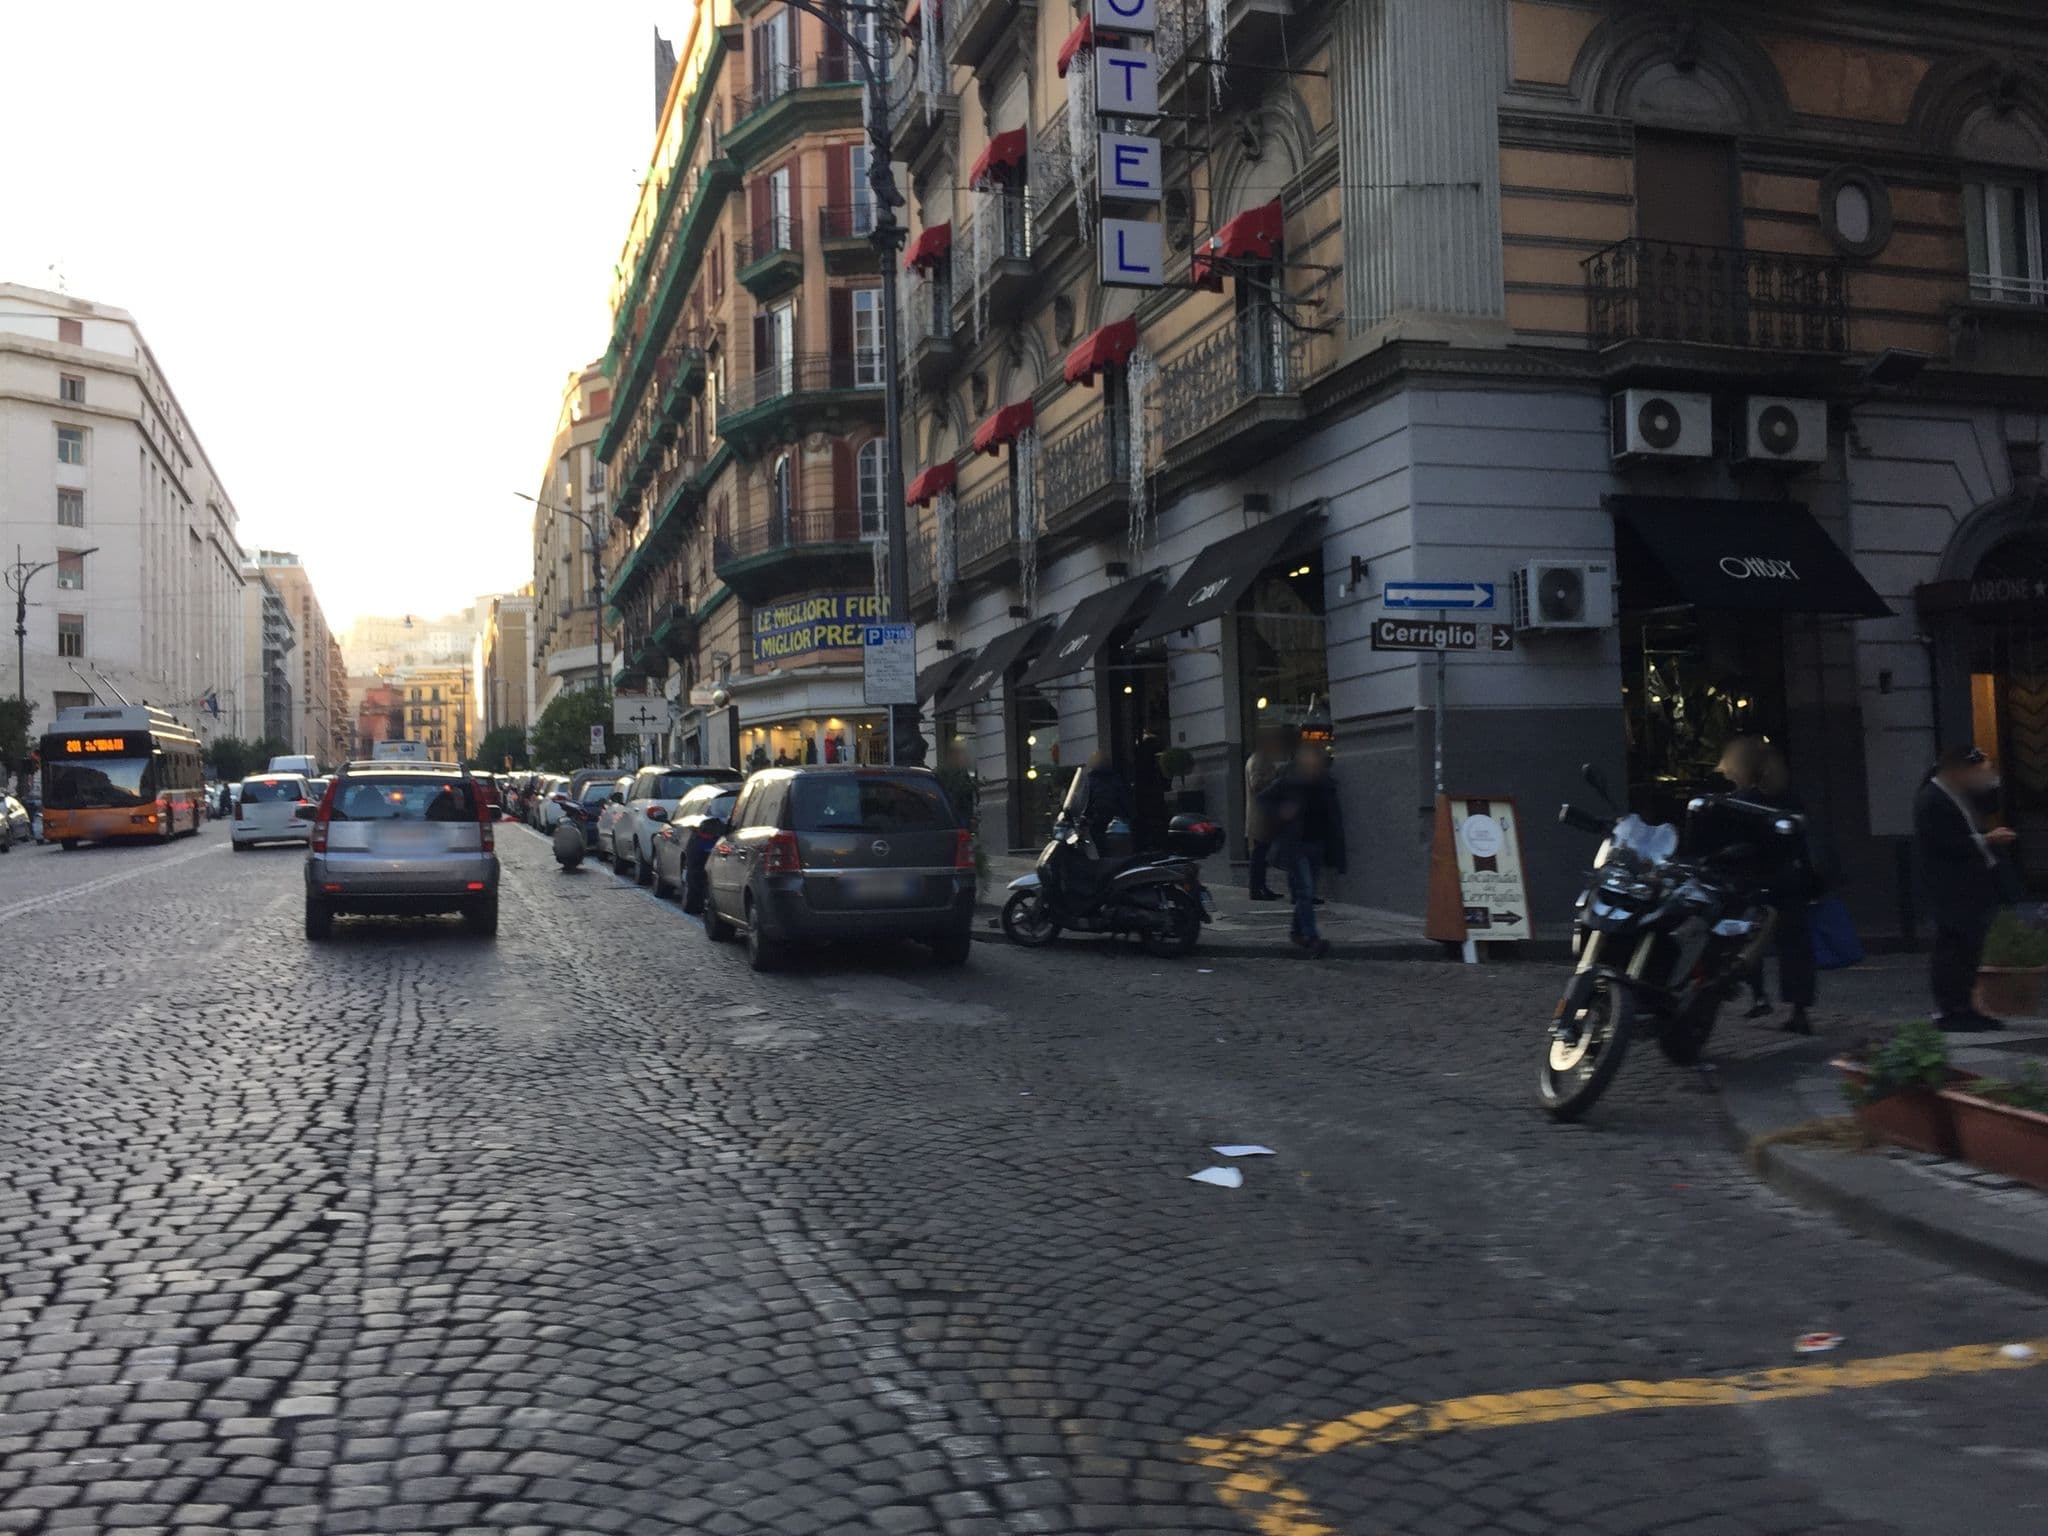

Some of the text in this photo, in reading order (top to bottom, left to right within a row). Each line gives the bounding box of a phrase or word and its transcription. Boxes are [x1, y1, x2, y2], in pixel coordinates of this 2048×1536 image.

[757, 611, 772, 633] LE
[774, 598, 839, 629] MIGLIORI
[761, 628, 812, 658] MIGLIOR
[1380, 621, 1476, 649] Cerriglio
